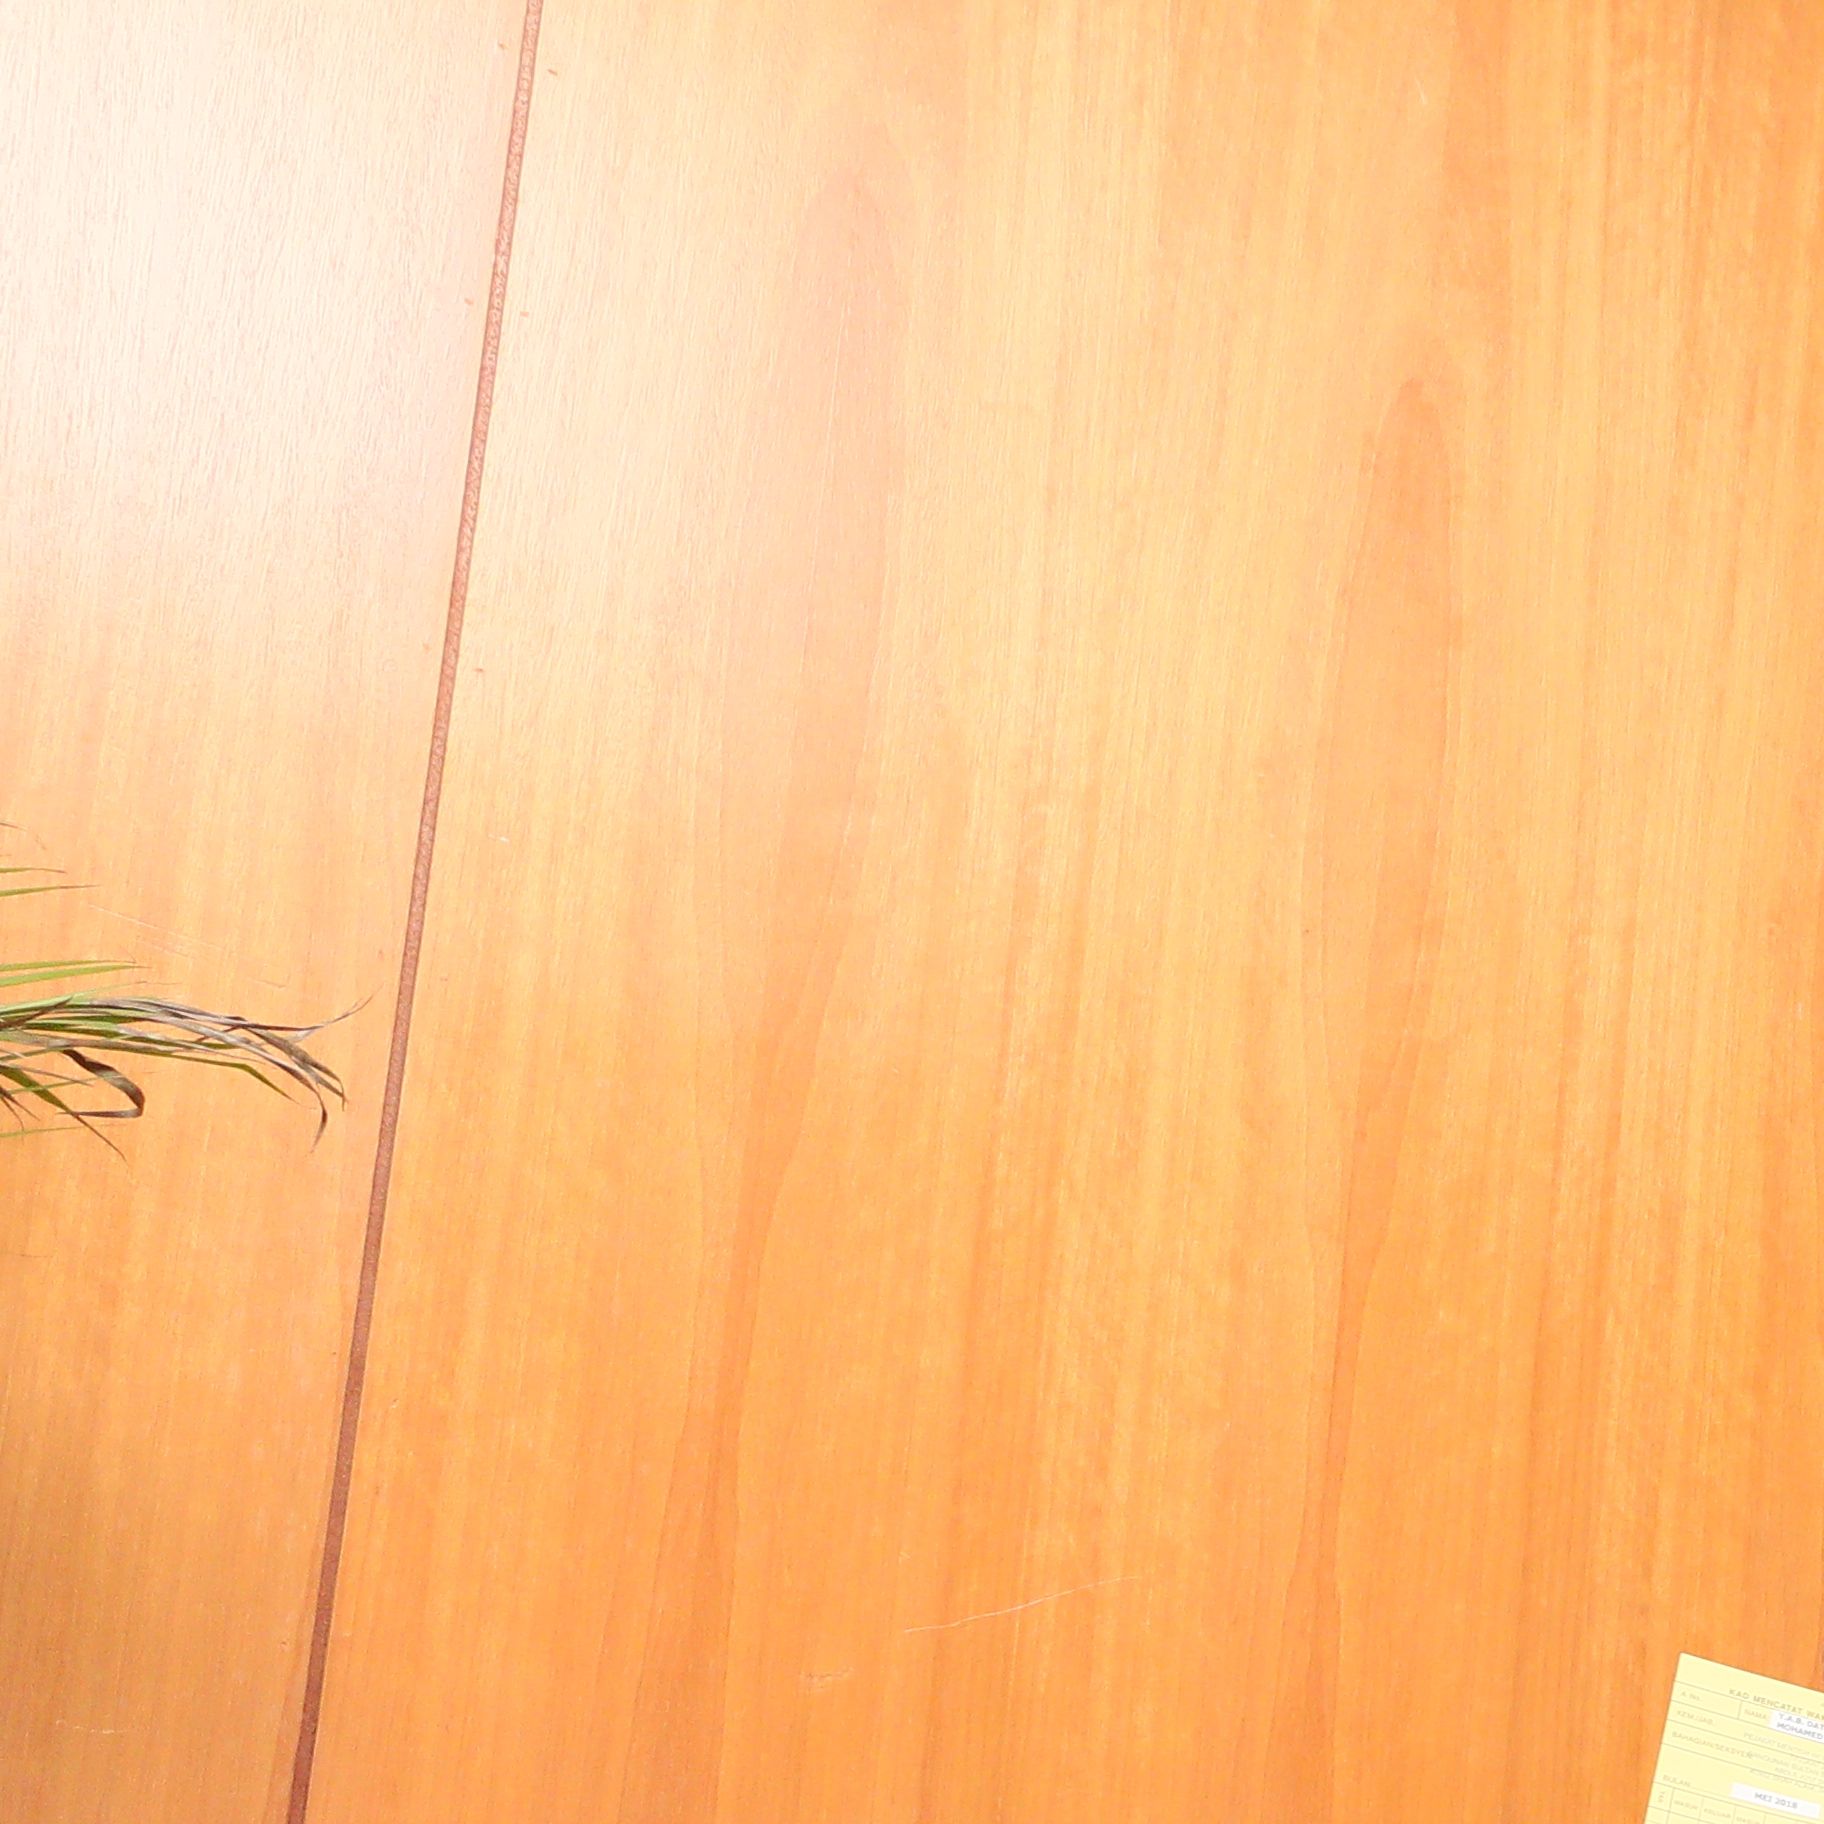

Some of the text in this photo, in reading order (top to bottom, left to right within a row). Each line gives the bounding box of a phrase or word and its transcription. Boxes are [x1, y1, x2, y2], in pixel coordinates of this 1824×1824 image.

[1729, 1688, 1749, 1698] KAD
[1753, 1694, 1802, 1714] MENCATAT
[1776, 1721, 1823, 1740] MOHAMED
[1754, 1792, 1797, 1809] MEI 2018
